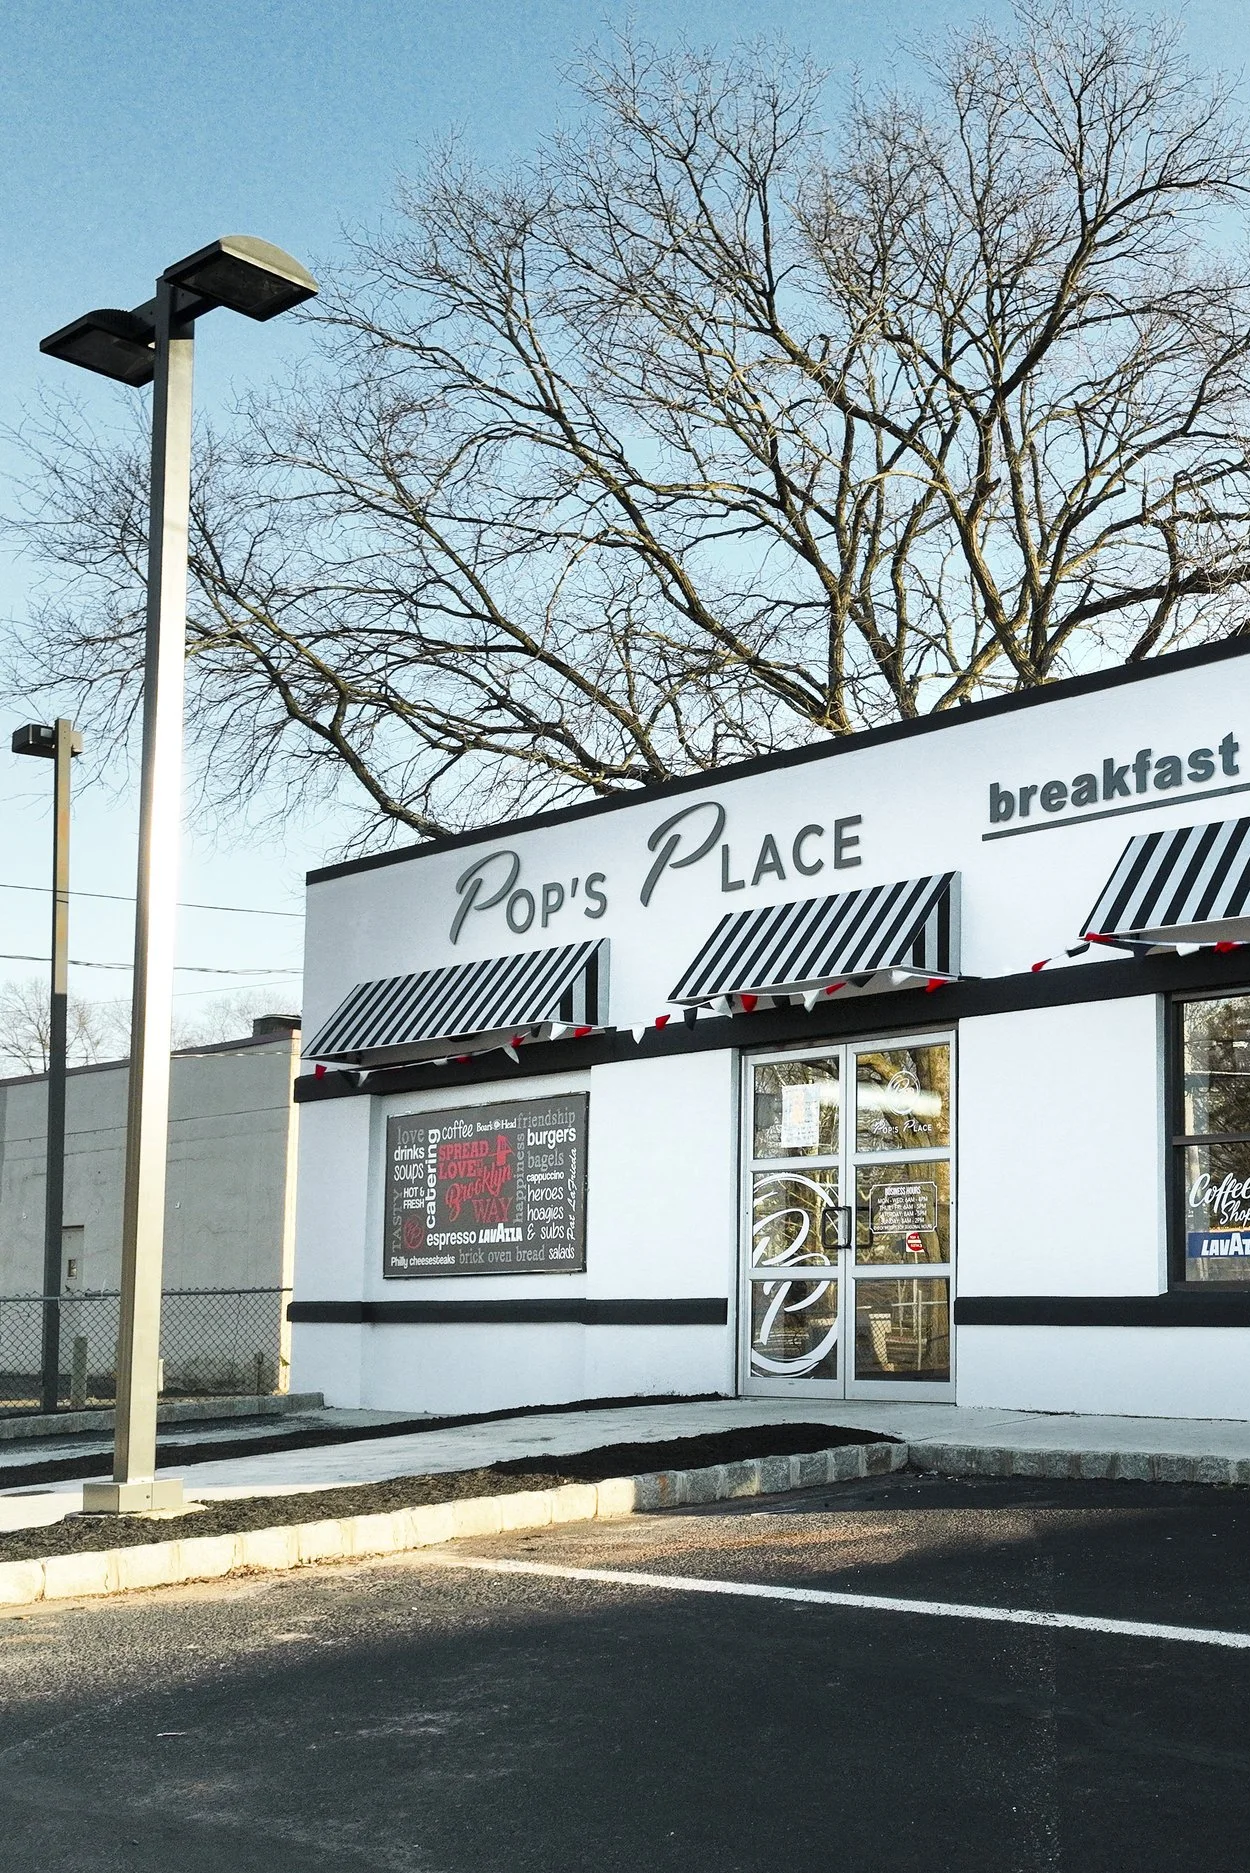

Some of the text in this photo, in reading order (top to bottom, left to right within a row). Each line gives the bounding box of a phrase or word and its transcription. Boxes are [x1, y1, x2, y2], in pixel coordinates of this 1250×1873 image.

[989, 732, 1240, 823] breakfast
[449, 801, 863, 946] POP'S PLACE
[517, 1107, 575, 1128] friendship
[903, 1119, 932, 1132] PLACE
[397, 1126, 425, 1144] love
[442, 1120, 473, 1140] coffee
[527, 1127, 576, 1149] burgers
[394, 1144, 425, 1161] drinks
[438, 1140, 489, 1160] SPREAD
[527, 1148, 564, 1171] bagels
[394, 1163, 424, 1184] soups
[425, 1129, 440, 1228] catering
[438, 1160, 476, 1180] LOVE
[513, 1132, 526, 1224] happiness
[526, 1170, 564, 1184] cappuccino
[403, 1186, 425, 1198] HOT &
[527, 1184, 564, 1202] heroes
[403, 1199, 425, 1209] FRESH
[472, 1197, 514, 1223] WAY
[527, 1203, 564, 1223] hoagies
[393, 1189, 402, 1252] TASTY
[426, 1231, 477, 1250] espresso
[478, 1222, 523, 1243] LAVAZZA
[526, 1222, 564, 1240] & subs
[390, 1254, 456, 1269] Philly cheesesteaks
[459, 1244, 545, 1264] brick oven bread
[548, 1244, 575, 1259] salads
